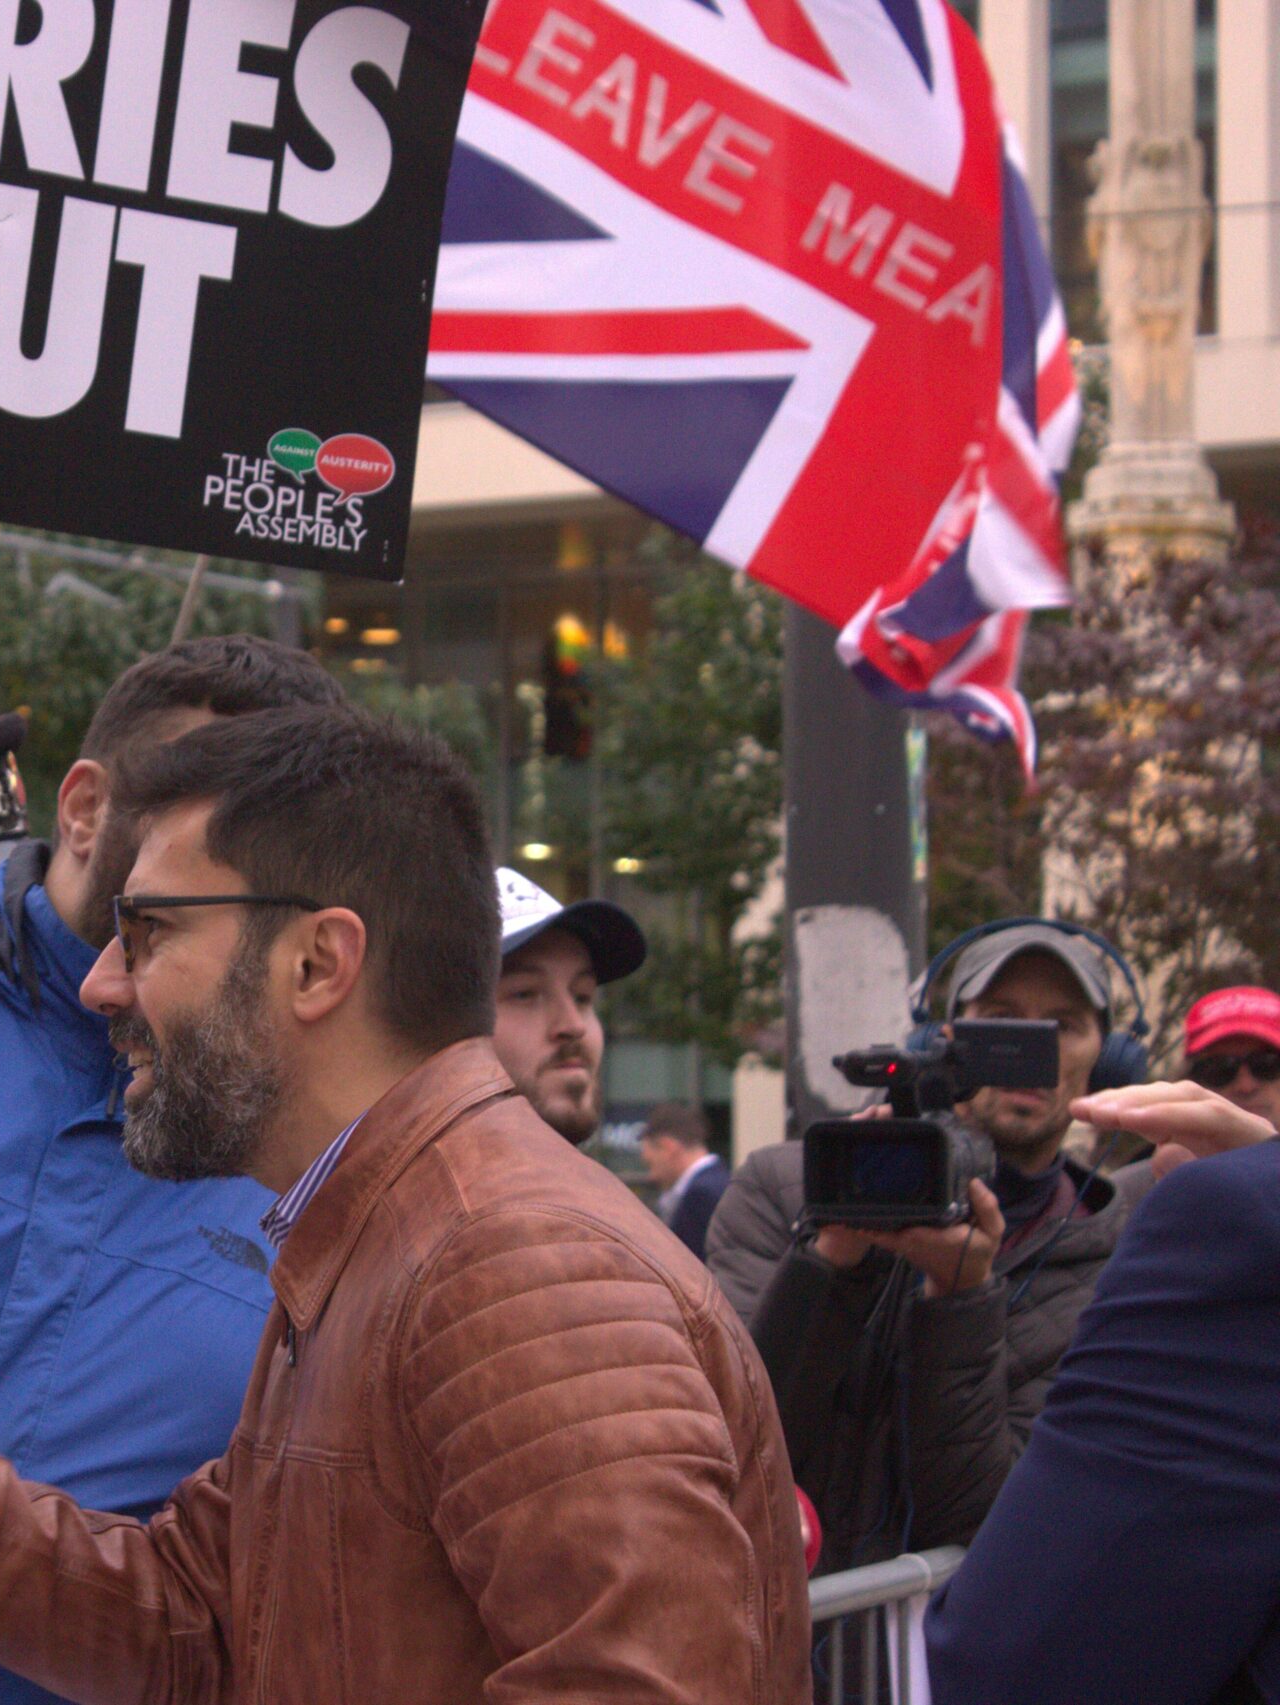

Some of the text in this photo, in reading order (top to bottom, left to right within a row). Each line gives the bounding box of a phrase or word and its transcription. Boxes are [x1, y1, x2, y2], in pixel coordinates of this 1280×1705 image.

[221, 452, 276, 484] THE
[273, 443, 390, 476] AGAINST AUSTERITY
[234, 511, 369, 553] ASSEMBLY
